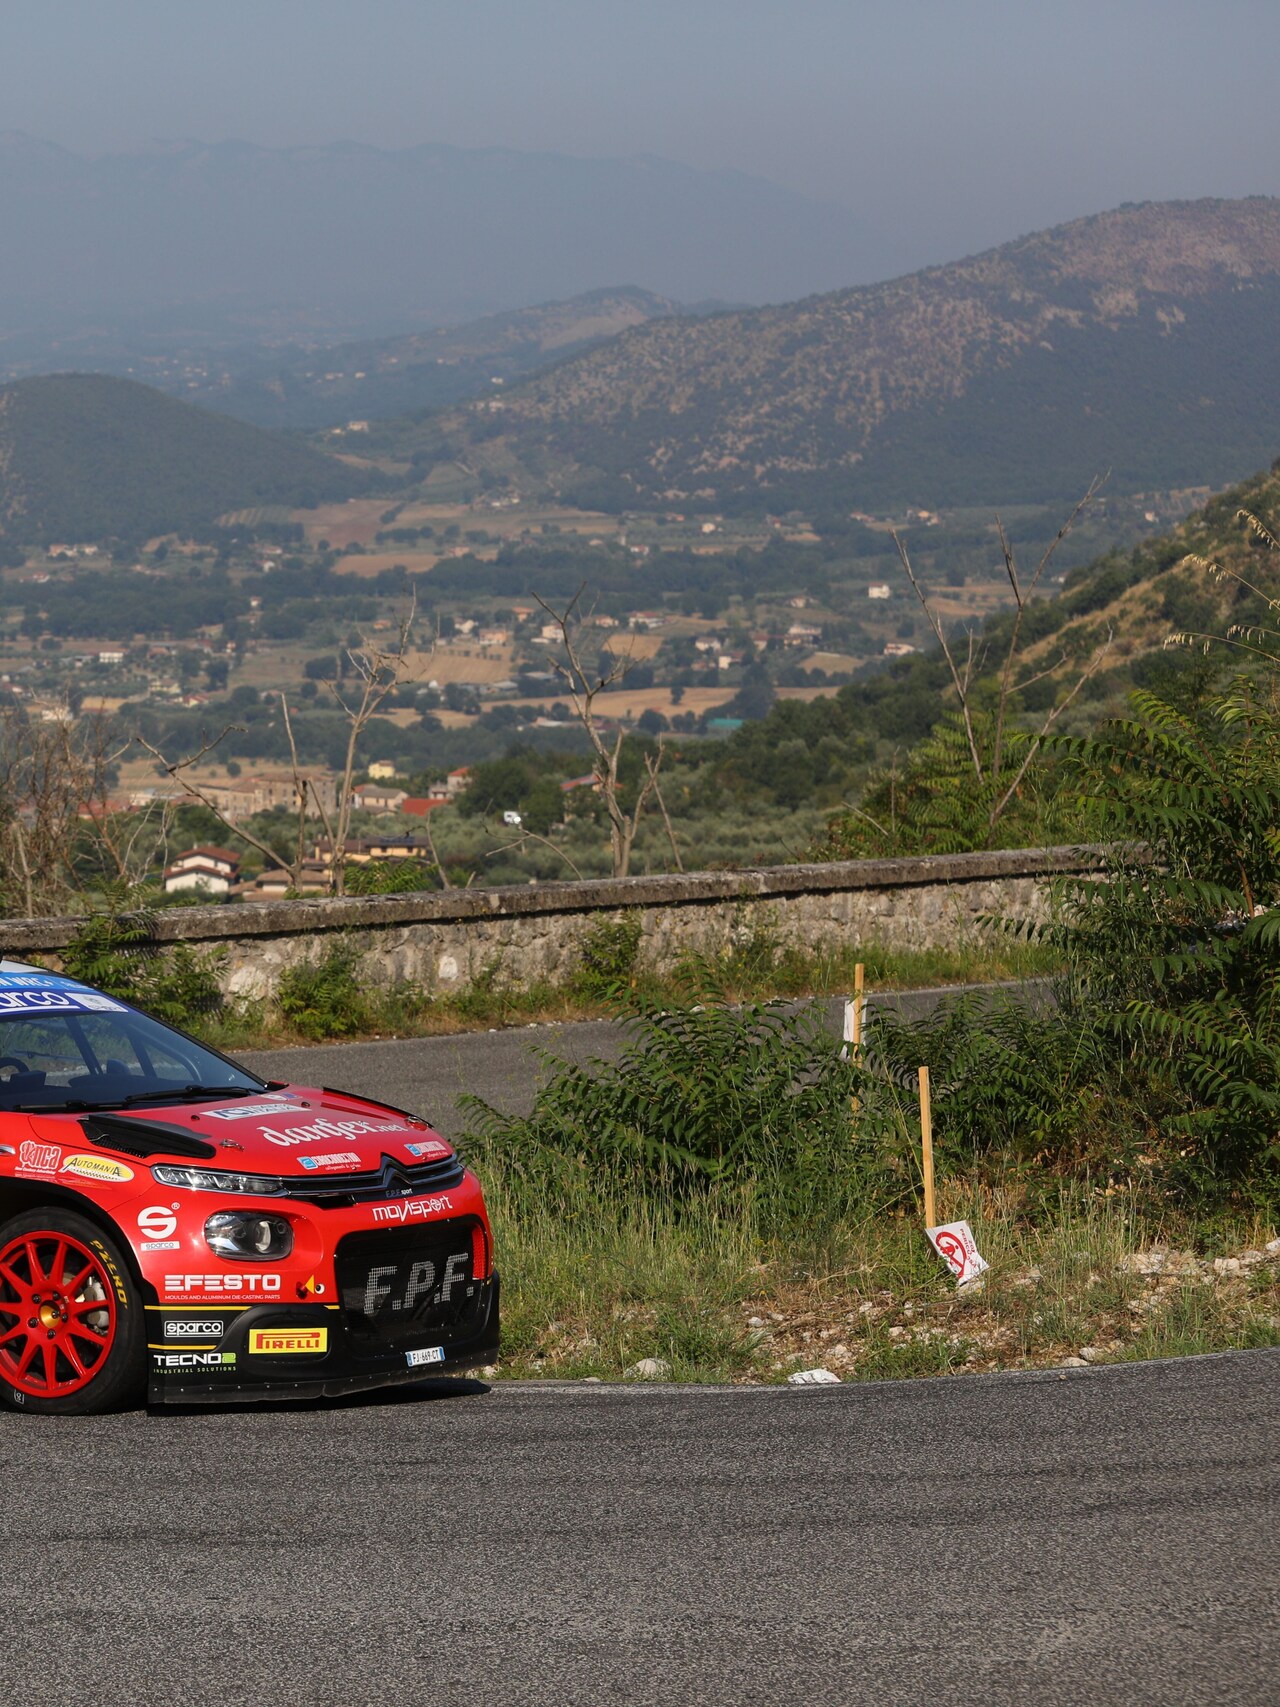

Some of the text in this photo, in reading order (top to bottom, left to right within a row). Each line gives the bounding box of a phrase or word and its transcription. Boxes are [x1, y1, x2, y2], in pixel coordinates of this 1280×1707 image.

[63, 1157, 122, 1177] AUTOMANIA
[165, 1274, 281, 1291] EFESTO
[166, 1322, 221, 1336] sparco
[256, 1332, 320, 1350] PIRELLI
[153, 1352, 237, 1367] TECNO2
[153, 1366, 237, 1375] INDUSTRIAL SOLUTIONS
